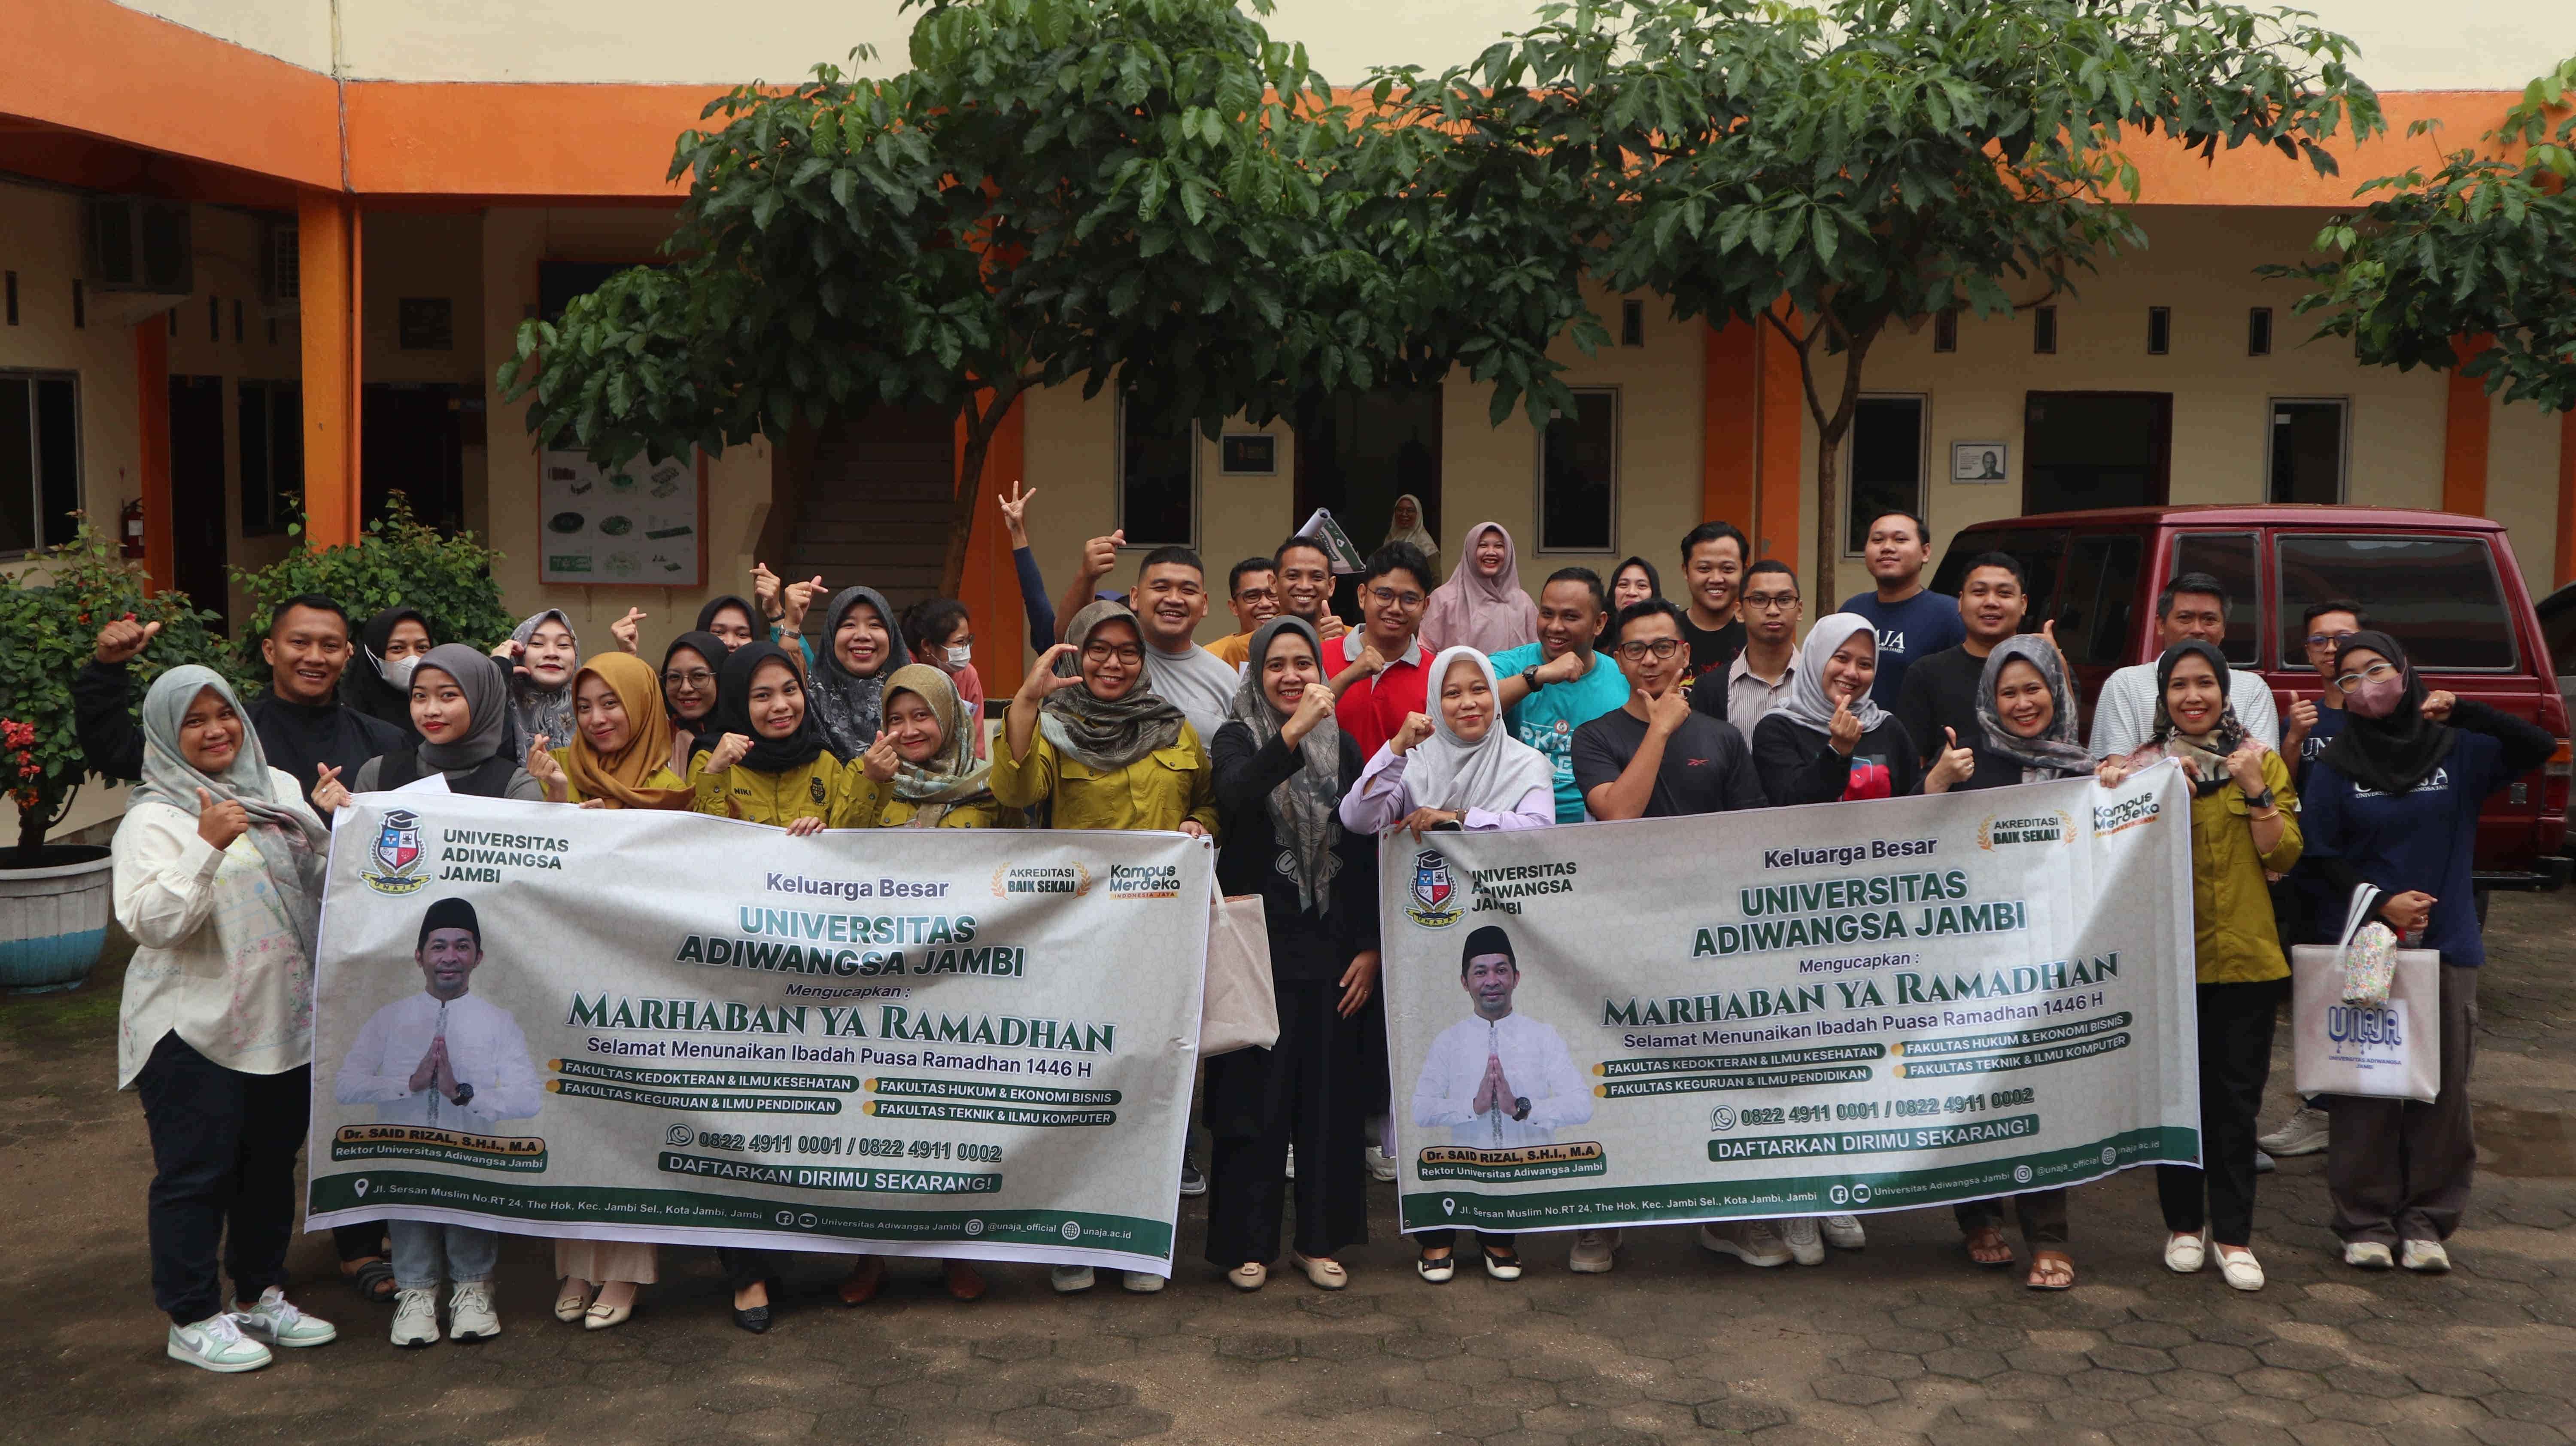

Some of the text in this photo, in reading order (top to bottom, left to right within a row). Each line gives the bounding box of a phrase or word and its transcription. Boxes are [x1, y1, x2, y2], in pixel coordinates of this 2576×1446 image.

[734, 788, 751, 796] NIKI
[2093, 792, 2153, 819] Kampus
[2094, 803, 2160, 831] Merdeka
[1994, 817, 2059, 829] AKREDITASI
[444, 829, 568, 852] UNIVERSITAS
[1993, 829, 2060, 845] BAIK SEKALI
[441, 847, 562, 870] ADIWANGSA
[1765, 839, 1937, 869] Keluarga Besar
[439, 866, 500, 883] JAMBI
[1009, 868, 1074, 878] AKREDITASI
[1109, 877, 1180, 892] Merdeka
[1111, 864, 1176, 880] Kampus
[374, 881, 416, 890] UNAJA
[766, 872, 949, 901] Keluarga Besar
[1008, 880, 1075, 893] BAIK SEKALI
[1741, 870, 1968, 917] UNIVERSITAS
[739, 906, 976, 944] UNIVERSITAS
[1418, 916, 1452, 924] UNAJA
[1693, 901, 2027, 957] ADIWANGSA JAMBI
[677, 936, 1024, 977] ADIWANGSA JAMBI
[1799, 953, 1911, 975] Mengucapkan
[786, 984, 901, 999] Mengucapkan
[1835, 978, 1887, 1009] YA
[818, 1006, 868, 1038] YA
[1624, 991, 2103, 1048] Selamat Menunaikan Ibadah Puasa Ramadhan 1446 H
[1907, 1016, 2123, 1053] FAKULTAS HUKUM & EKONOMI BISNIS
[587, 1037, 1092, 1078] Selamat Menunaikan Ibadah Puasa Ramadhan 1446 H
[1608, 1047, 1878, 1074] FAKULTAS KEDOKTERAN & ILMU KESEHATAN
[1911, 1036, 2125, 1075] FAKULTAS TEKNIK & ILMU KOMPUTER
[565, 1063, 851, 1090] FAKULTAS KEDOKTERAN & ILMU KESEHATAN
[1611, 1069, 1867, 1095] FAKULTAS KEGURUAN & ILMU PENDIDIKAN
[565, 1083, 835, 1112] FAKULTAS KEGURUAN & ILMU PENDIDIKAN
[881, 1081, 1112, 1103] FAKULTAS HUKUM & EKONOMI BISNIS
[880, 1104, 1110, 1124] FAKULTAS TEKNIK & ILMU KOMPUTER
[1741, 1087, 2034, 1125] 0822 4911 0001 / 0822 4911 0002
[344, 1129, 536, 1151] Dr. SAID RIZAL, S.H.I., M.A
[699, 1132, 1002, 1162] 0822 4911 0001 / 0822 4911 0002
[1719, 1119, 2030, 1157] DAFTARKAN DIRIMU SEKARANG!
[1427, 1146, 1595, 1163] Dr. SAID RIZAL, S.H.I., M.A
[2036, 1157, 2099, 1176] @unaja_official
[669, 1156, 991, 1191] DAFTARKAN DIRIMU SEKARANG!
[1422, 1162, 1603, 1178] Rektor Universitas Adiwangsa Jambi
[1874, 1172, 2010, 1196] Universitas Adiwangsa Jambi
[1473, 1207, 1503, 1218] Sersan
[1507, 1208, 1542, 1218] Muslim
[1546, 1206, 1574, 1215] No.RT
[1578, 1205, 1592, 1214] 24,
[1596, 1203, 1613, 1212] The
[1616, 1201, 1639, 1211] Hok,
[1642, 1200, 1664, 1209] Kec.
[1667, 1197, 1696, 1208] Jambi
[1700, 1197, 1721, 1207] Sel.,
[1725, 1194, 1747, 1205] Kota
[1750, 1193, 1784, 1204] Jambi,
[1786, 1192, 1817, 1202] Jambi
